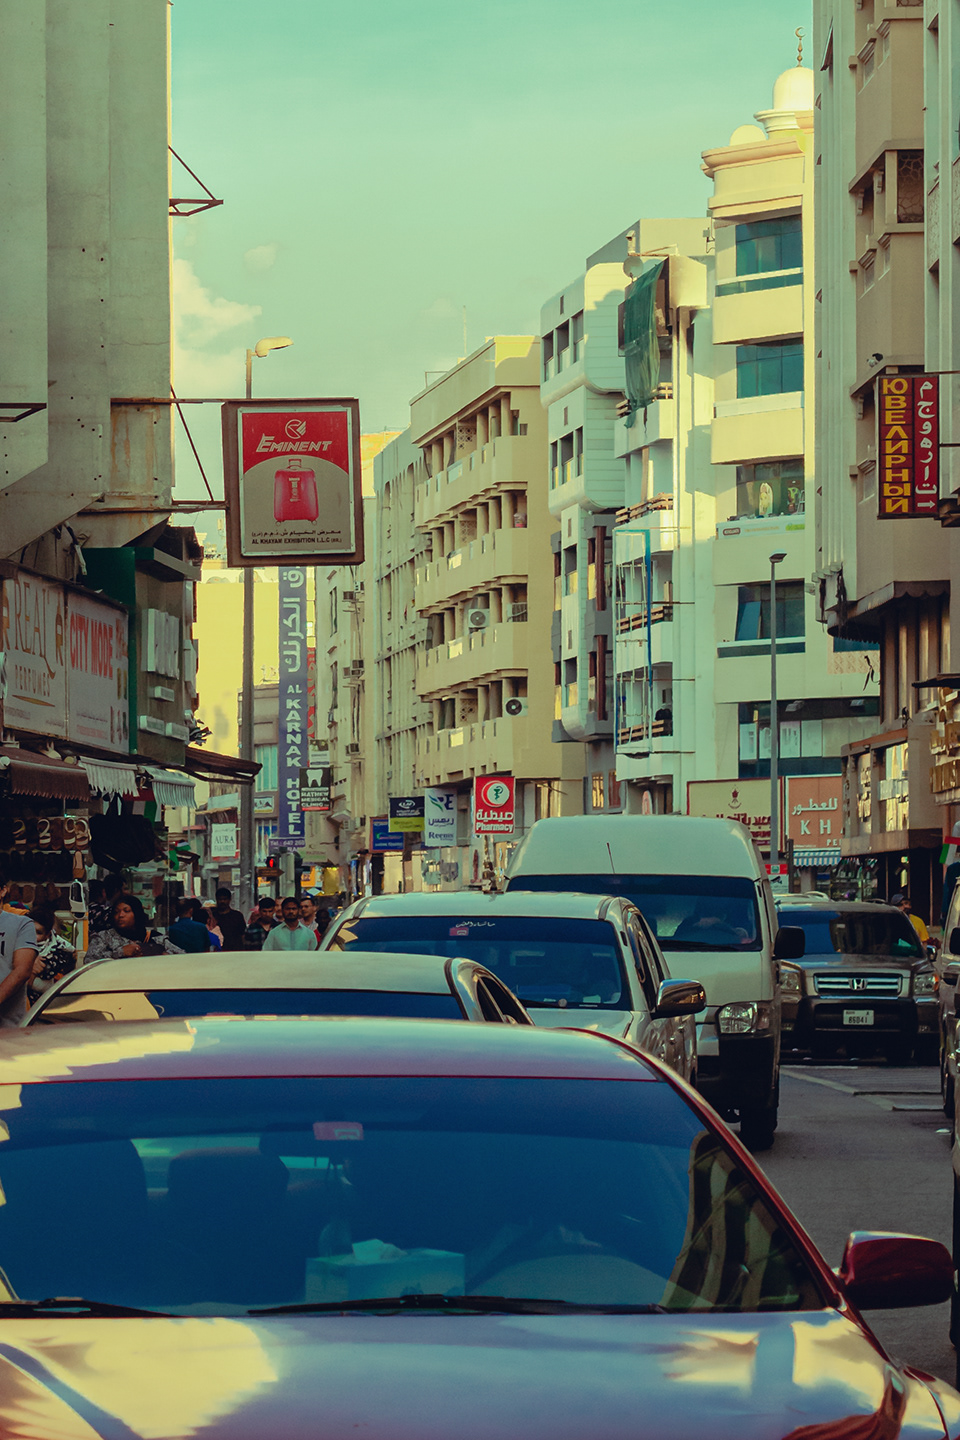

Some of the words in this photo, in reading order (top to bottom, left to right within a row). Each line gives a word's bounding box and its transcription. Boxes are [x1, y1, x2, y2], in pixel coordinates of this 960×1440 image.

[882, 378, 911, 513] ЮВЕЛИРНЫЙ
[915, 381, 937, 495] مجوهرات
[69, 611, 89, 674] CITY
[90, 618, 113, 680] MODE
[286, 684, 303, 694] AL
[285, 698, 302, 767] KARNAK
[286, 778, 303, 835] HOTEL
[476, 823, 513, 833] Pharmacy
[791, 797, 838, 816] للعطور
[214, 835, 235, 844] AURA
